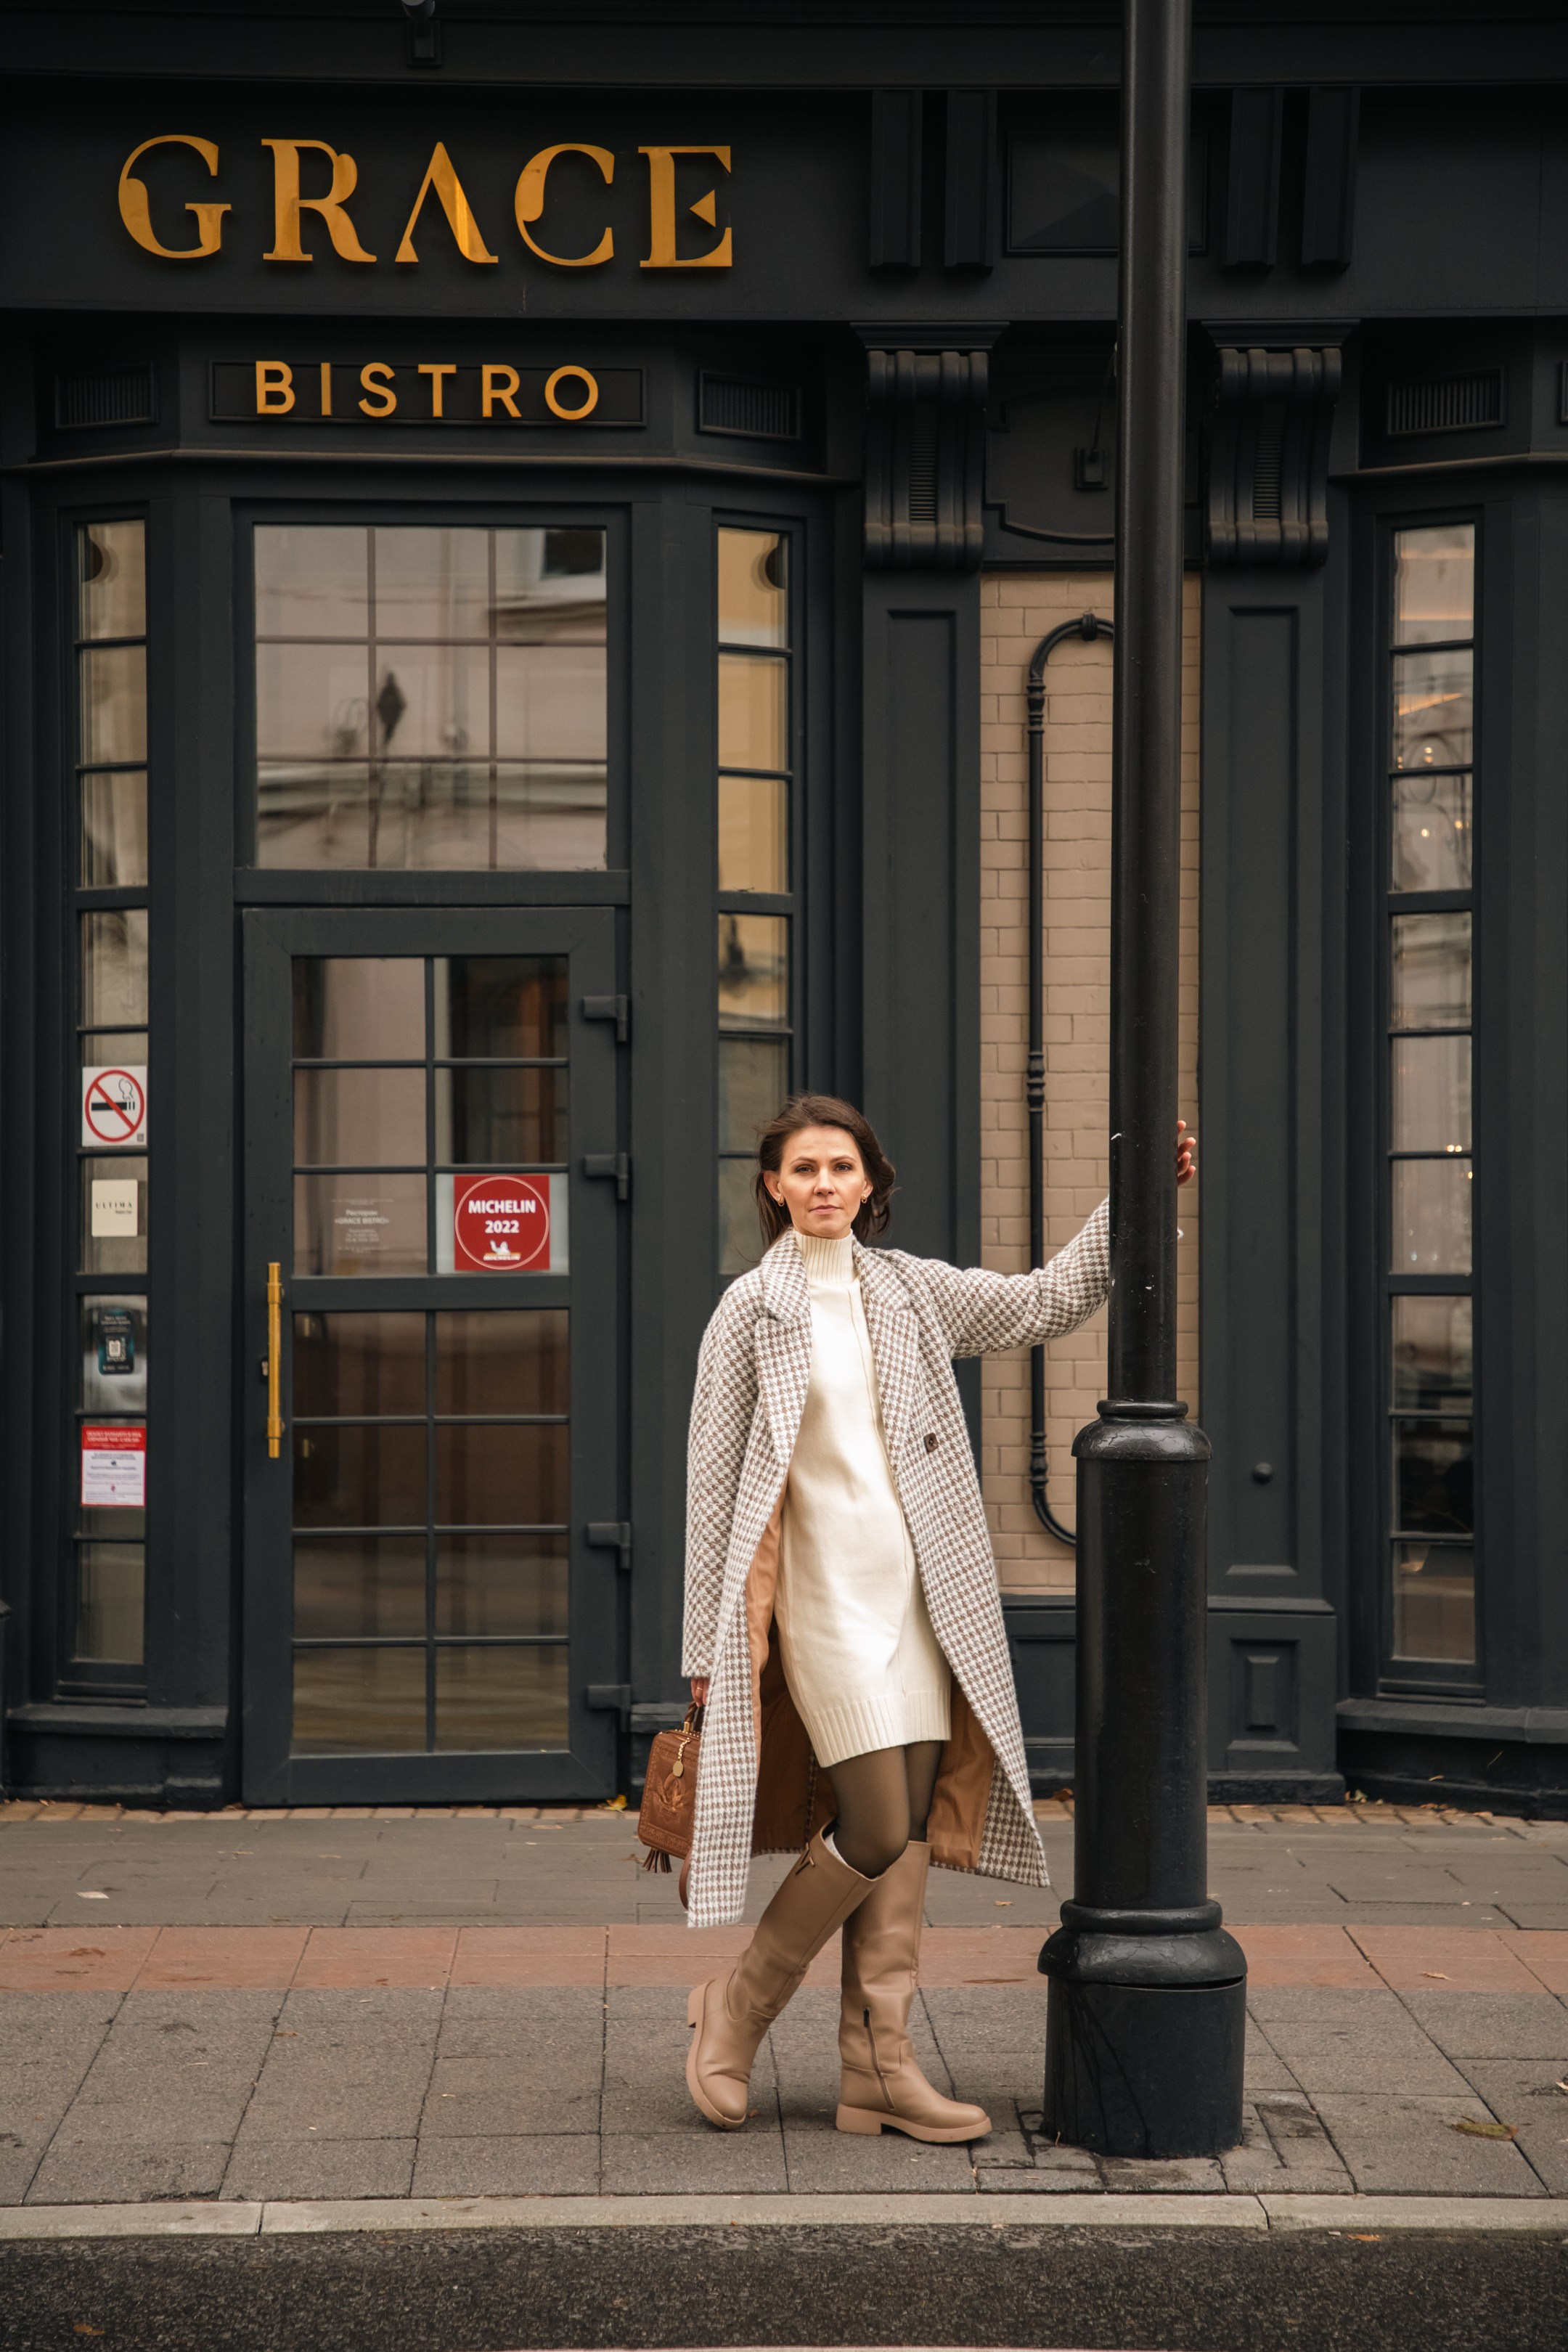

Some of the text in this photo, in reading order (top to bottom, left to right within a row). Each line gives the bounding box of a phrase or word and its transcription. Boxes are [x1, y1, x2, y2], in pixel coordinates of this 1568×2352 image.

[118, 134, 733, 269] GRACE
[255, 360, 600, 421] BISTRO
[468, 1199, 536, 1214] MICHELIN
[484, 1220, 520, 1233] 2022
